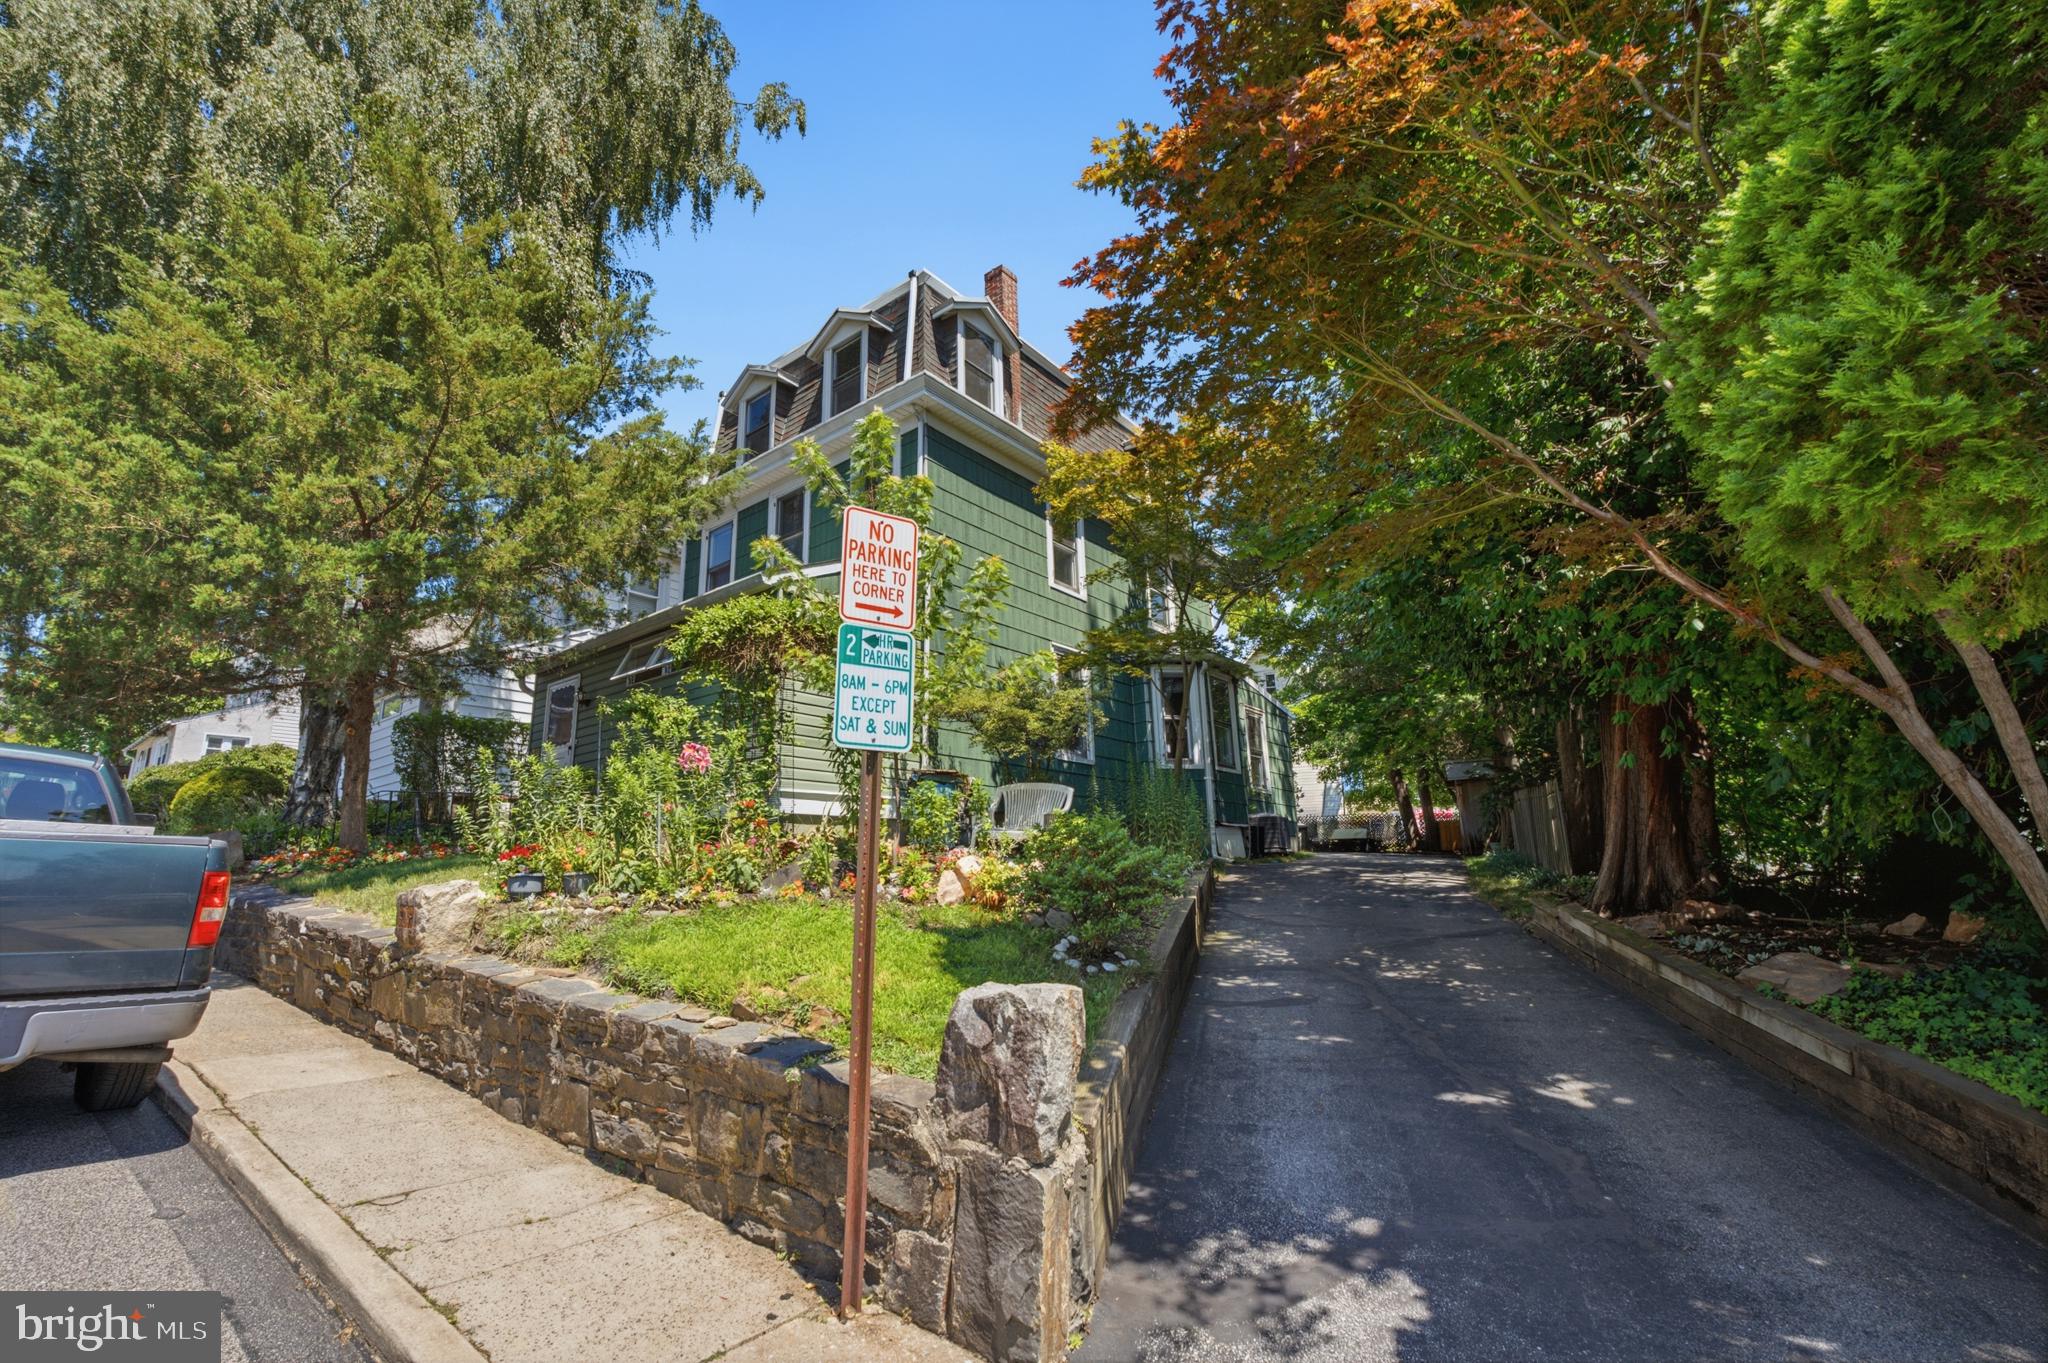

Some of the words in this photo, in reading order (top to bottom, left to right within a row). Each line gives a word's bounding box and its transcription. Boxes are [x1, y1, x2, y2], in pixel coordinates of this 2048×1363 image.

[869, 520, 894, 544] NO
[849, 539, 911, 571] PARKING
[852, 563, 886, 582] HERE
[892, 571, 906, 587] TO
[853, 581, 904, 603] CORNER
[846, 634, 857, 656] 2
[879, 634, 894, 649] HR
[863, 648, 908, 668] PARKING
[841, 674, 866, 690] 8AM
[884, 680, 908, 696] 6PM
[852, 696, 896, 714] EXCEPT
[840, 716, 861, 732] SAT
[866, 718, 876, 734] &
[883, 720, 907, 736] SUN
